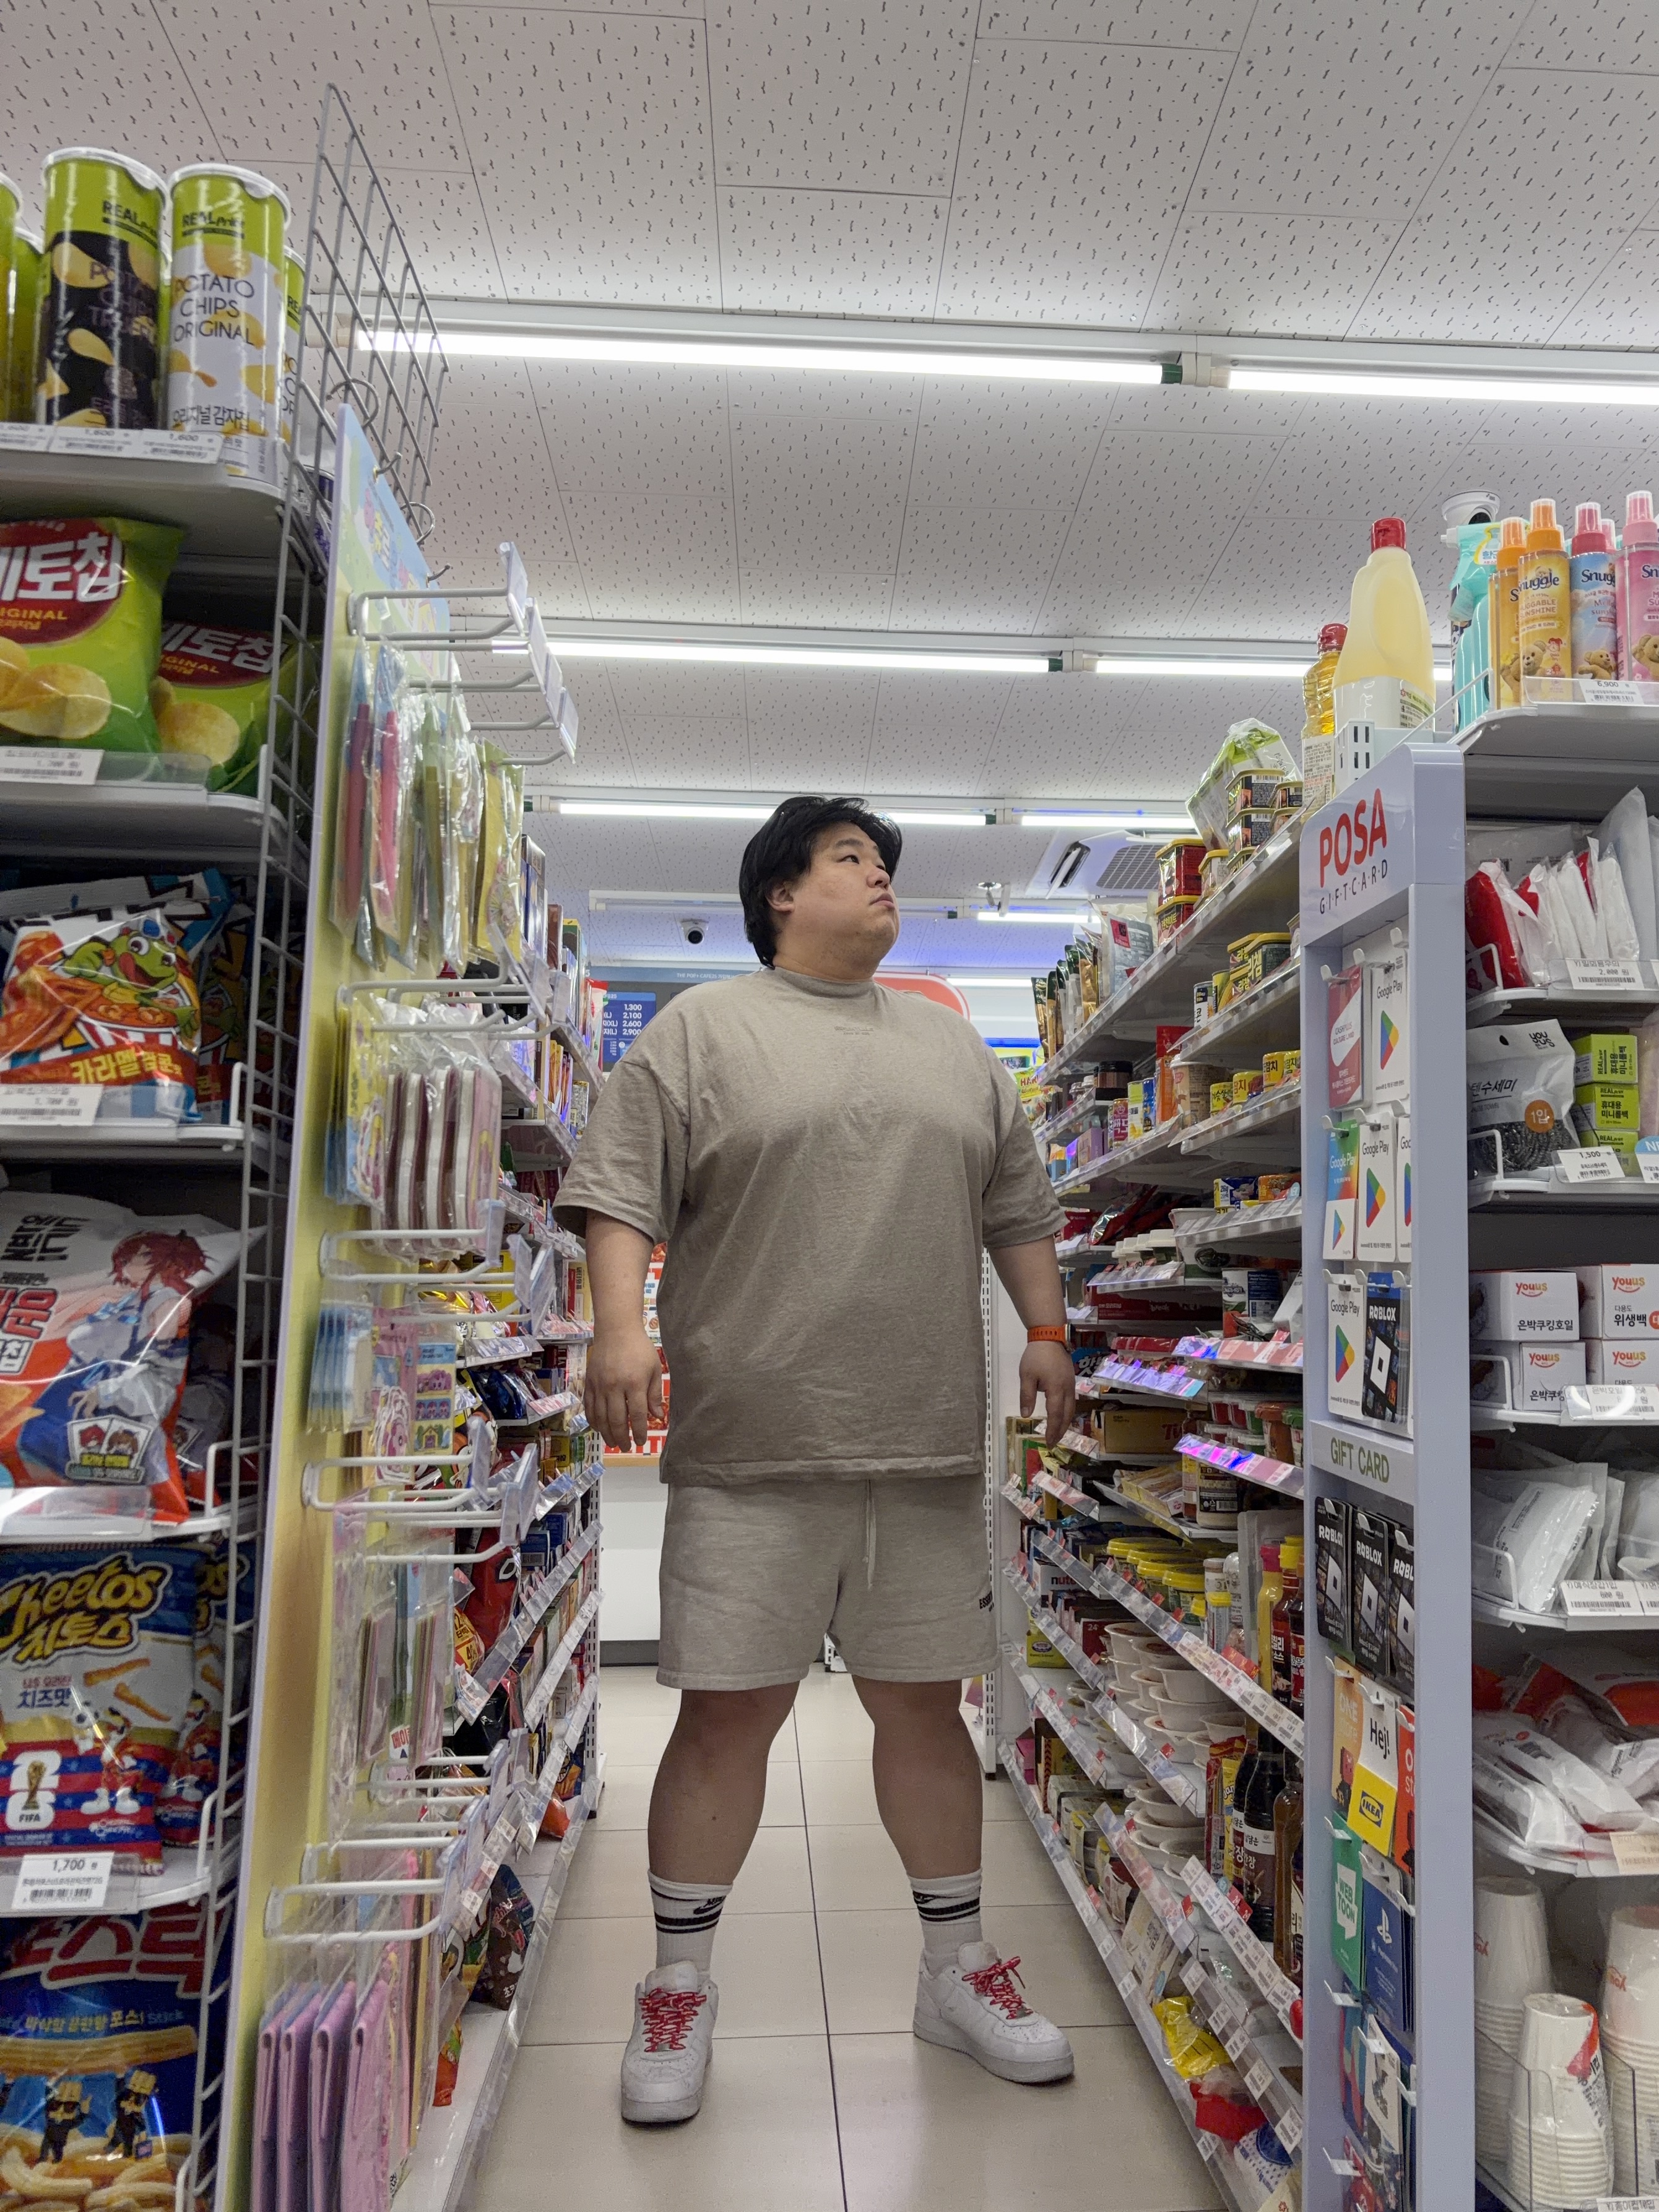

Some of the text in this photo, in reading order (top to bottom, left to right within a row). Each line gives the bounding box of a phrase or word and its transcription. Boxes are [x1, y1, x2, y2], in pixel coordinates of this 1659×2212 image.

[180, 297, 240, 318] CHIPS
[173, 320, 254, 345] ORIGINAL
[1319, 788, 1387, 889] POSA
[1377, 979, 1403, 1000] Google Play
[624, 1003, 642, 1011] 1,300
[70, 1048, 141, 1084] 카라멜
[1601, 1101, 1622, 1110] 휴대용
[1530, 1108, 1550, 1124] 1입
[1362, 1141, 1389, 1157] Google Play
[1580, 1151, 1601, 1159] 1,500
[1330, 1152, 1356, 1171] Google Play
[1515, 1282, 1548, 1295] youus
[1612, 1277, 1645, 1290] youus
[1331, 1299, 1359, 1317] Google Play
[1369, 1305, 1397, 1322] ROBLOX
[1517, 1320, 1574, 1331] 은박쿠킹호일
[1614, 1314, 1647, 1327] 위생백
[1529, 1352, 1560, 1365] youus
[1612, 1350, 1646, 1365] youus
[1331, 1436, 1390, 1484] GIFT CARD
[1319, 1524, 1343, 1547] ROBLOX
[1356, 1540, 1383, 1566] ROBLOX
[14, 1612, 131, 1663] 치토스
[17, 1687, 72, 1709] 치즈맛
[1339, 1692, 1358, 1724] ONE
[1370, 1717, 1390, 1760] Hej!
[19, 1813, 41, 1823] FIFA
[1362, 1799, 1381, 1819] IKEA
[52, 1859, 85, 1872] 1,700
[1339, 1878, 1354, 1904] WEB
[1337, 1892, 1356, 1924] TOON
